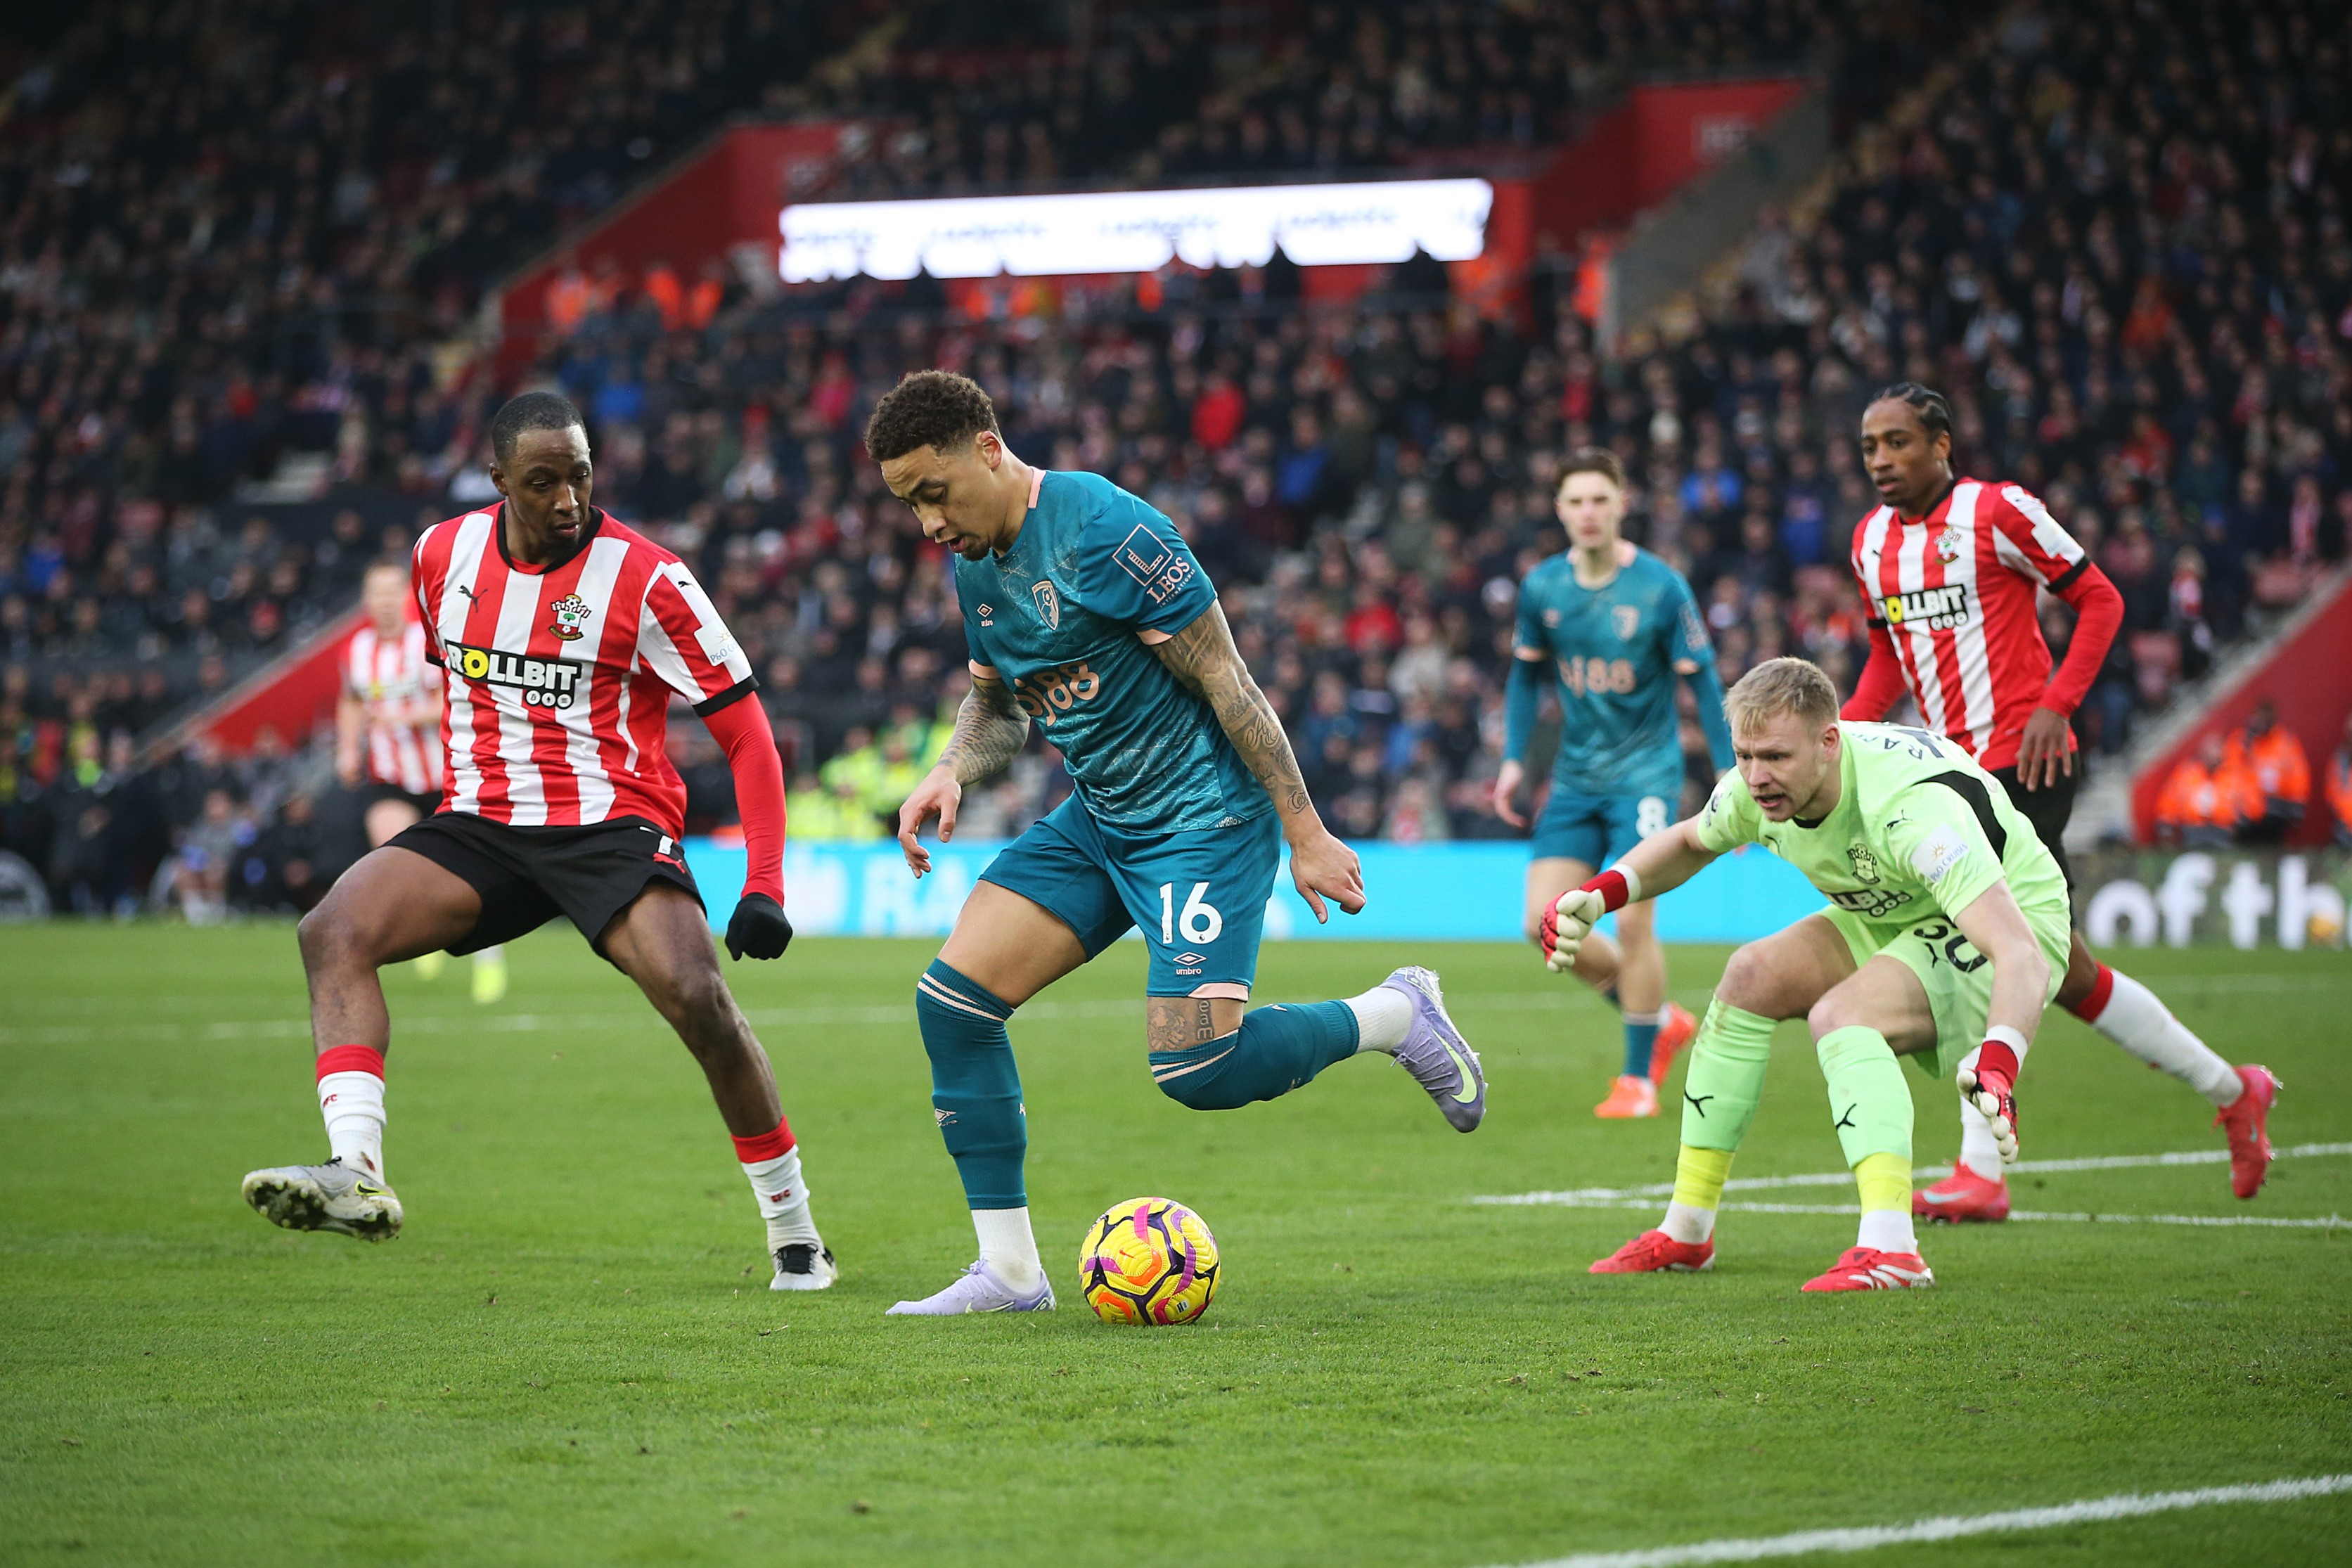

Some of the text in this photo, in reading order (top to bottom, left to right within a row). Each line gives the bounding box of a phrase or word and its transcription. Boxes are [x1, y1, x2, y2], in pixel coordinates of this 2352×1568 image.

[1146, 556, 1190, 604] LEOS
[1159, 568, 1195, 608] INTERNATIONAL
[446, 643, 578, 690] ROLLBIT
[1219, 816, 1238, 828] UMBRO
[1636, 795, 1669, 840] 8
[1159, 882, 1223, 944] 16
[2086, 851, 2352, 951] of th
